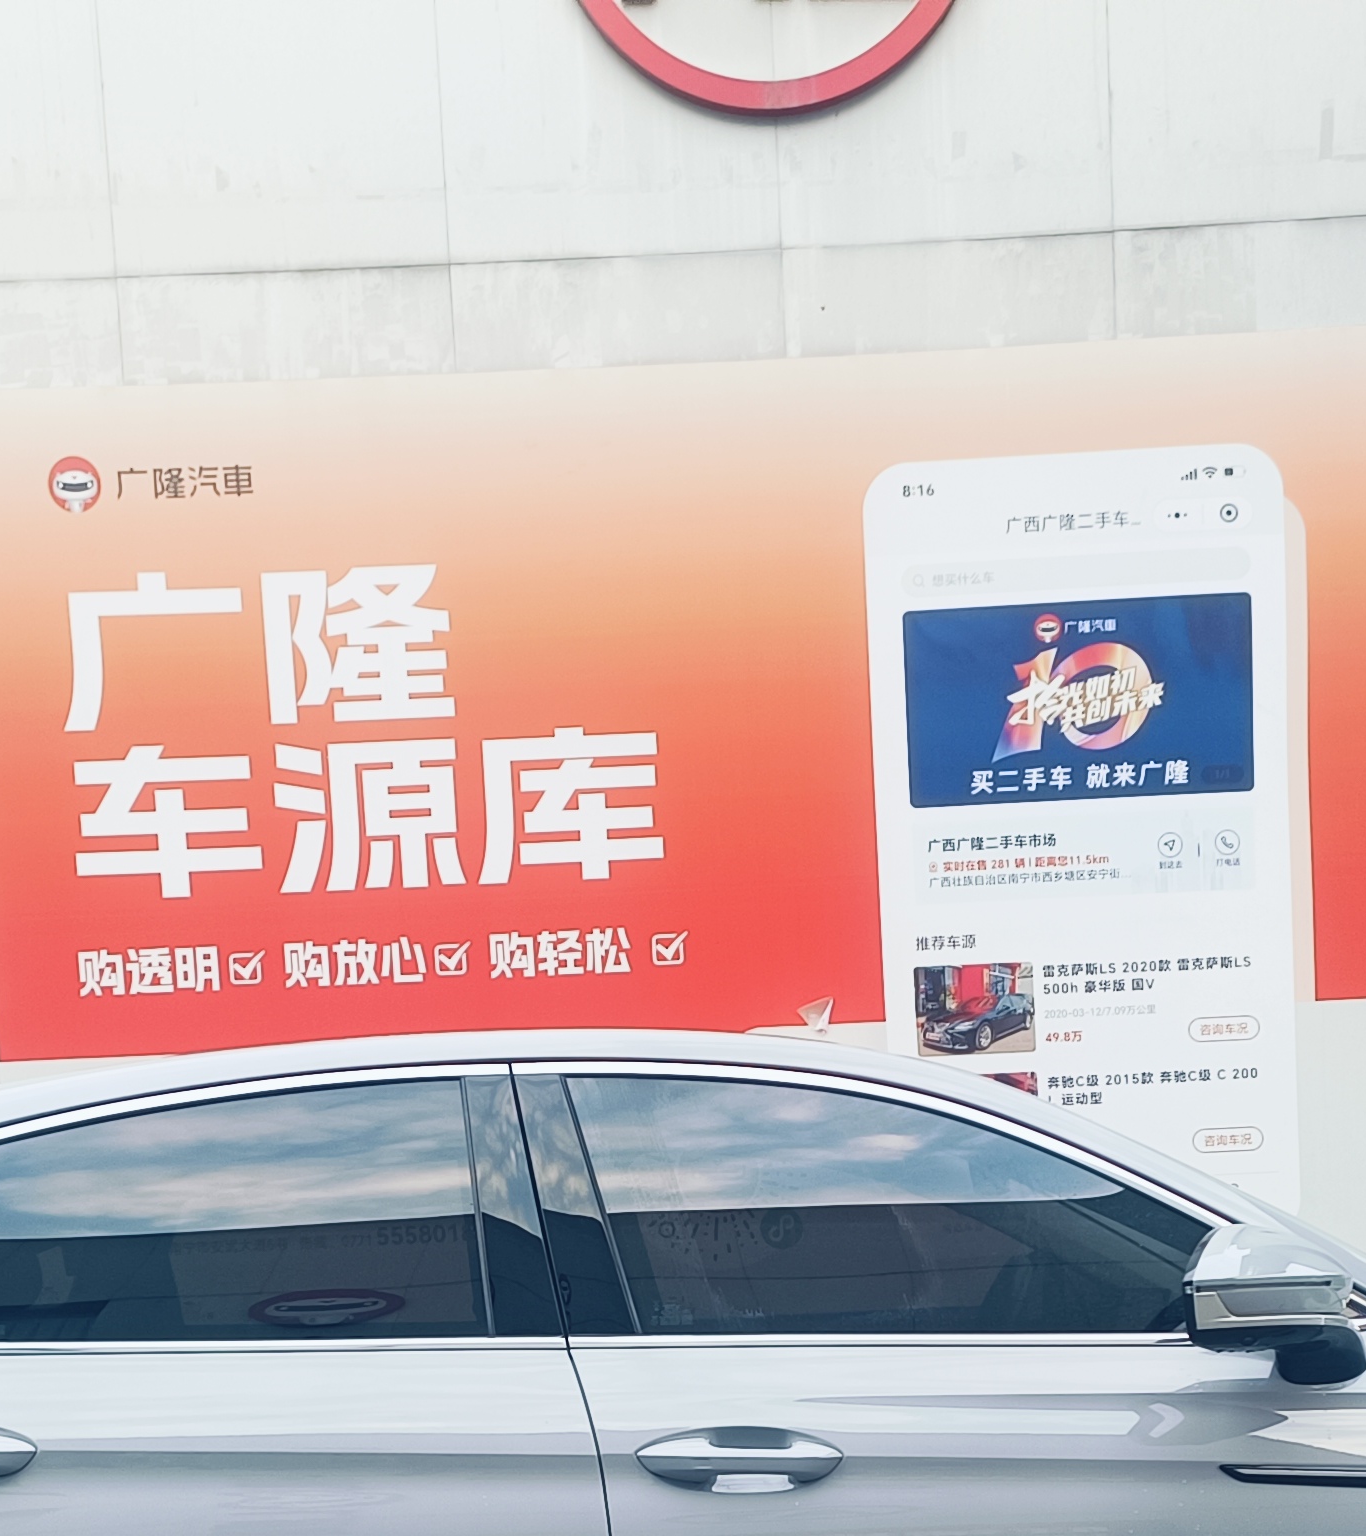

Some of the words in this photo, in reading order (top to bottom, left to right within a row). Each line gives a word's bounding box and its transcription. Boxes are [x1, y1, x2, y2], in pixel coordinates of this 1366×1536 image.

[901, 483, 935, 498] 8:16
[62, 562, 457, 733] 广隆
[1060, 681, 1165, 733] 共创未来
[970, 763, 1073, 796] 买二手车
[1084, 758, 1191, 790] 就来广隆
[72, 725, 666, 899] 车源库
[927, 833, 1057, 853] 广西广隆二手车市场
[991, 859, 1011, 870] 281
[915, 933, 977, 952] 推荐车源
[76, 945, 223, 997] 购透明
[282, 936, 427, 990] 购放心
[488, 926, 631, 980] 购轻松
[1042, 962, 1117, 978] 雷克萨斯LS
[1121, 959, 1172, 974] 2020款
[1176, 955, 1252, 971] 雷克萨斯LS
[1042, 981, 1079, 995] 500h
[1084, 978, 1127, 994] 豪华版
[1045, 1030, 1083, 1043] 49.8万
[1199, 1022, 1250, 1036] 咨询车况
[1047, 1074, 1100, 1090] 奔驰C级
[1105, 1071, 1154, 1086] 2015款
[1159, 1069, 1212, 1084] 奔驰C级
[1217, 1069, 1227, 1080] C
[1232, 1067, 1259, 1080] 200
[1061, 1091, 1103, 1106] 运动型
[1204, 1132, 1253, 1147] 咨询车况
